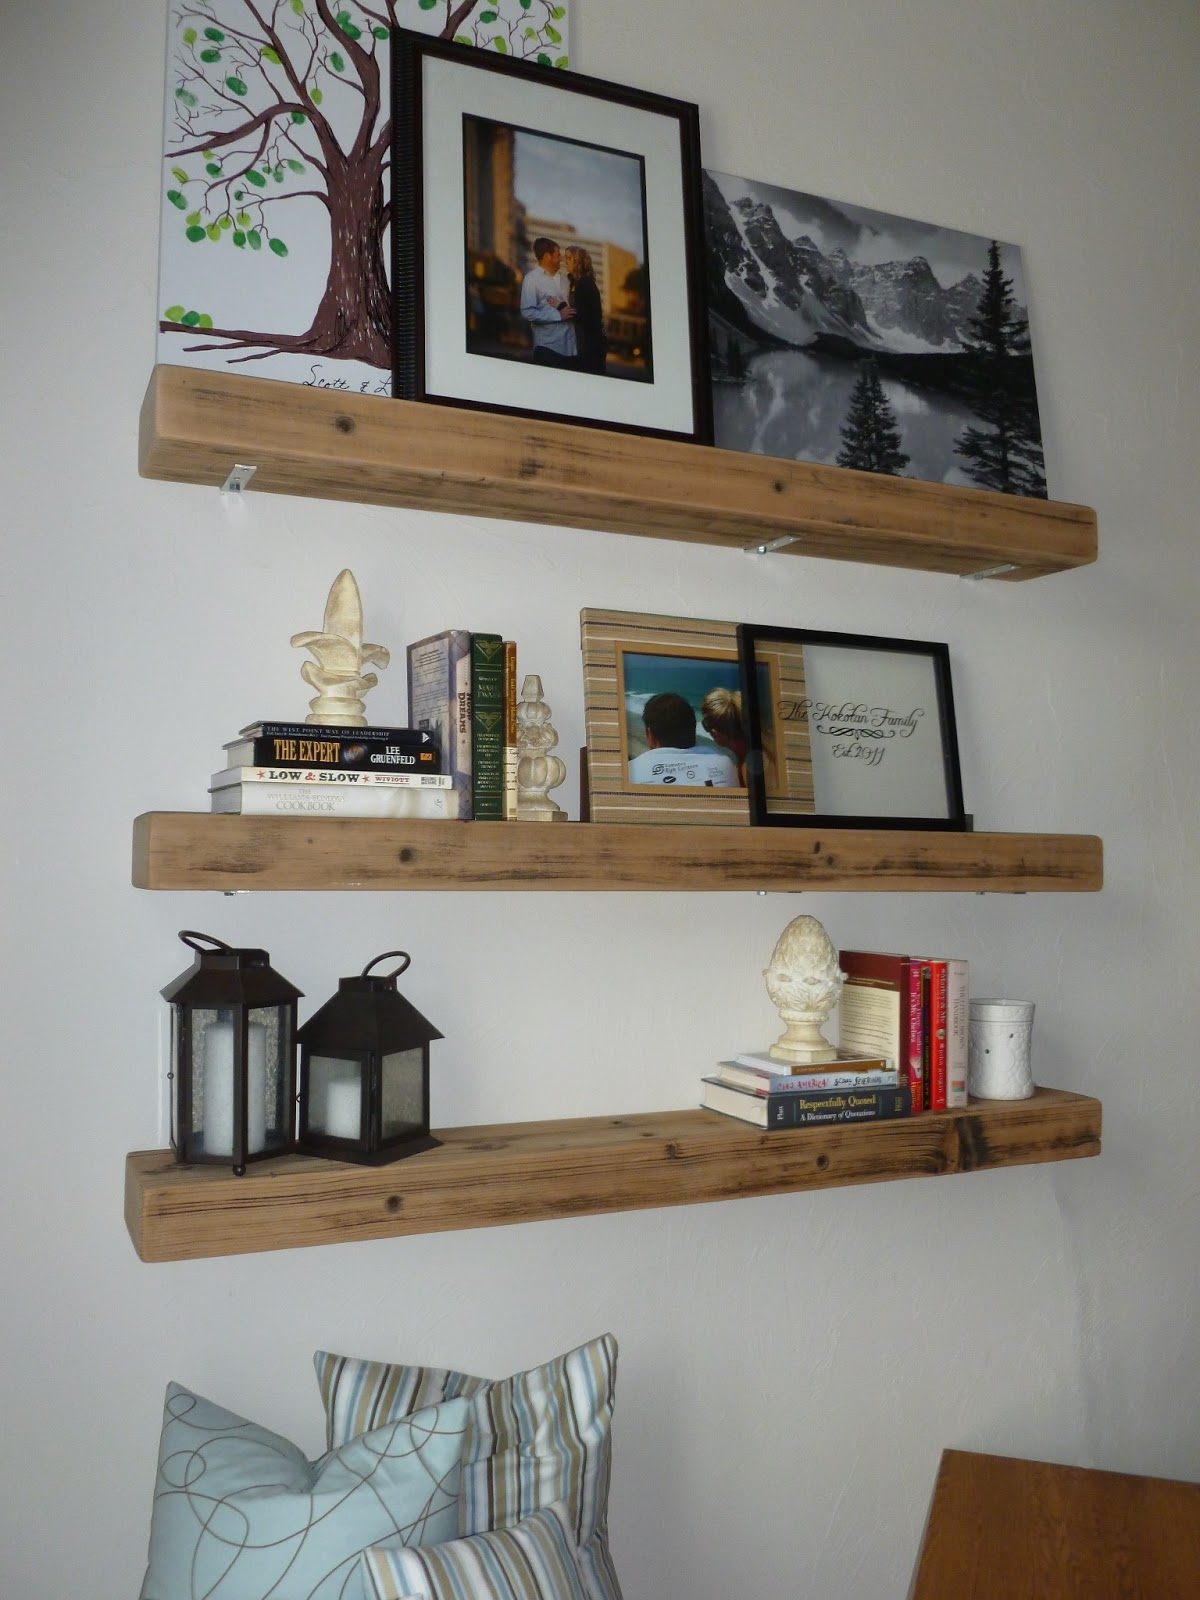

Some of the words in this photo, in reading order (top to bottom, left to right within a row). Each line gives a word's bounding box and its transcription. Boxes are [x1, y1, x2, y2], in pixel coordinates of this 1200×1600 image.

[302, 364, 350, 390] Scott
[458, 692, 466, 734] DREAMS
[777, 699, 813, 721] The
[869, 706, 925, 738] Family
[352, 729, 390, 737] LEADERSHIP
[273, 738, 298, 760] THE
[298, 740, 341, 763] EXPERT
[385, 746, 401, 755] LEE
[370, 753, 416, 765] GRUENFELD
[268, 770, 302, 781] LOW
[304, 771, 316, 781] &
[318, 772, 360, 783] SLOW
[267, 793, 345, 803] WILLIAMS-SONOMA
[276, 801, 336, 811] COOKBOOK
[940, 1010, 946, 1024] Me
[799, 1096, 847, 1111] Respectfully
[847, 1094, 877, 1107] Quoted
[800, 1113, 807, 1121] A
[807, 1111, 837, 1121] Dictionary
[837, 1111, 845, 1120] of
[845, 1109, 877, 1119] Quotations
